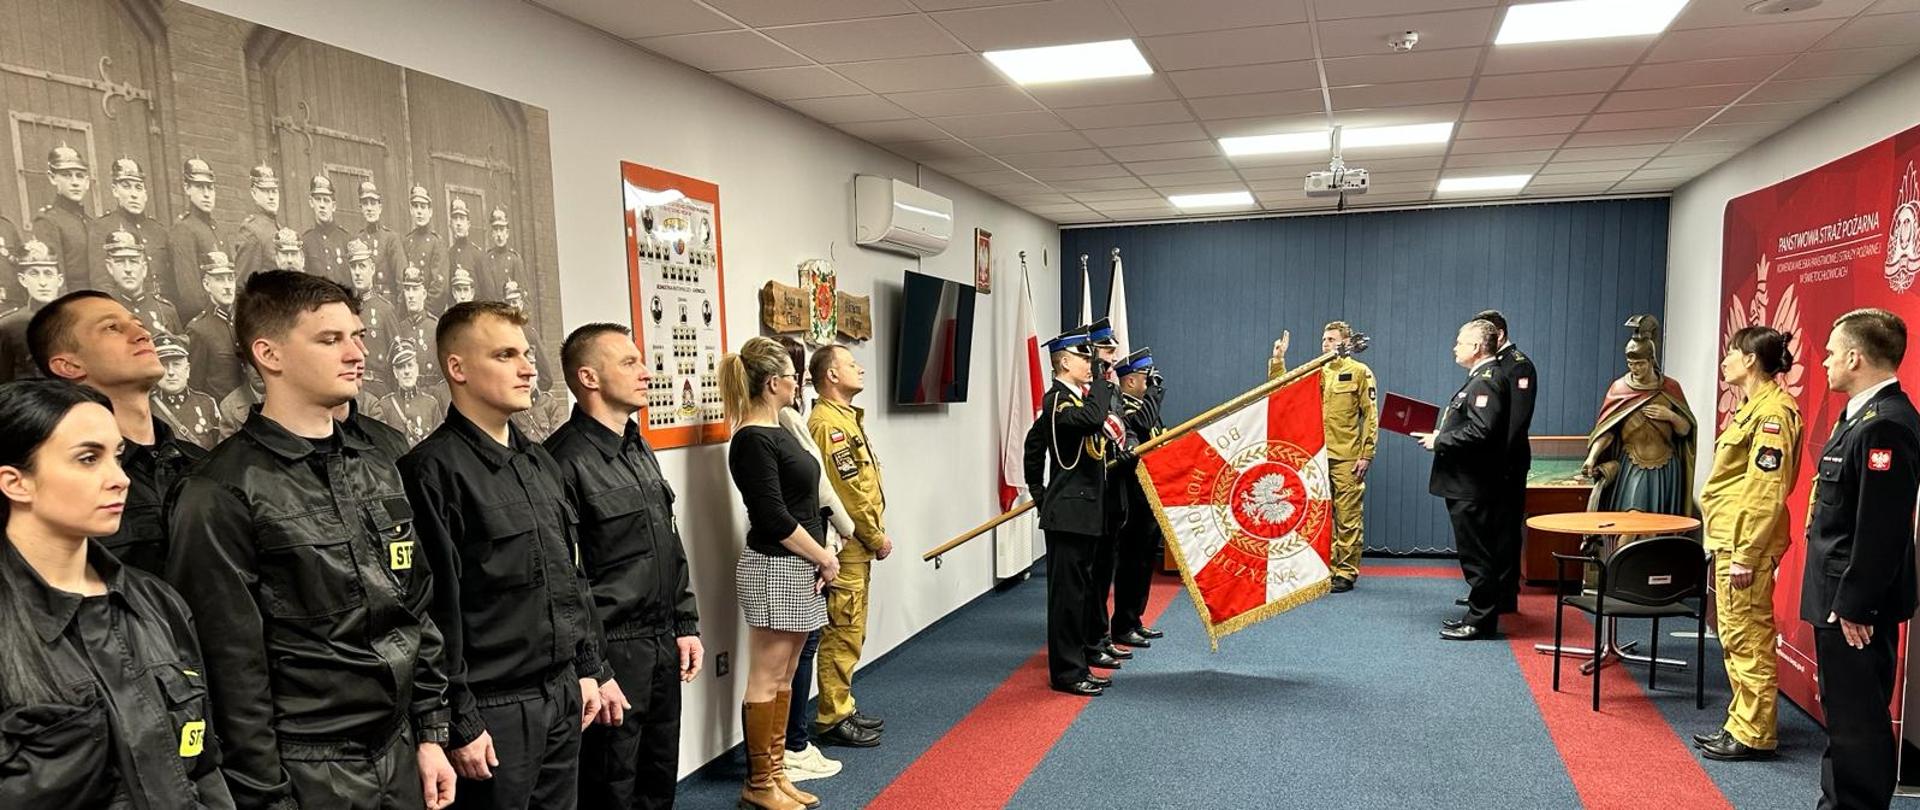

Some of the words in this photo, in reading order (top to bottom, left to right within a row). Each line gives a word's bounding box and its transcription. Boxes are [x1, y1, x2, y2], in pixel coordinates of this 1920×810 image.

[1778, 230, 1819, 253] PAŃSTWOWA
[1819, 219, 1842, 244] STRAŻ
[1842, 212, 1879, 238] POŻARNA
[1187, 468, 1206, 537] HONOR
[1204, 544, 1298, 584] OJCZYZNA
